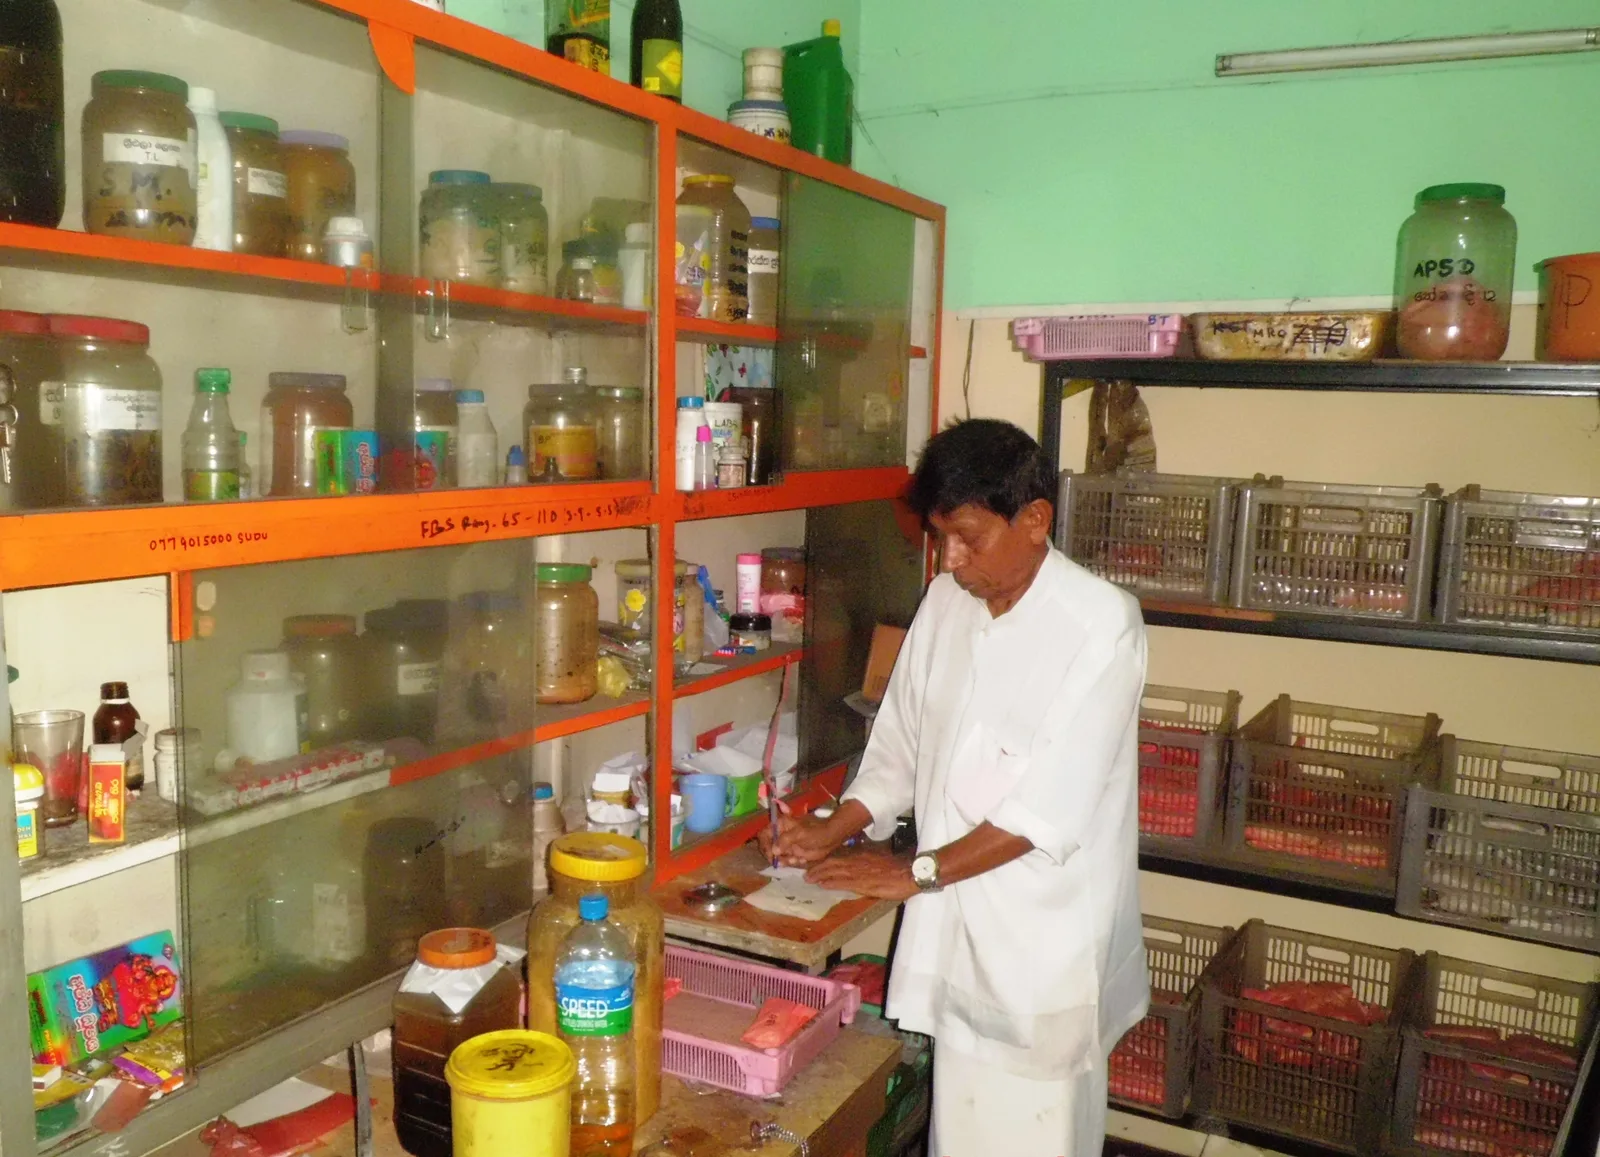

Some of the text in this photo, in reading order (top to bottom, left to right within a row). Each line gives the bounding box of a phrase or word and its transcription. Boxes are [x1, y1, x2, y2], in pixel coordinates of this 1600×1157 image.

[1413, 258, 1475, 278] APSD
[502, 512, 520, 528] 65
[561, 997, 608, 1019] SPEED
